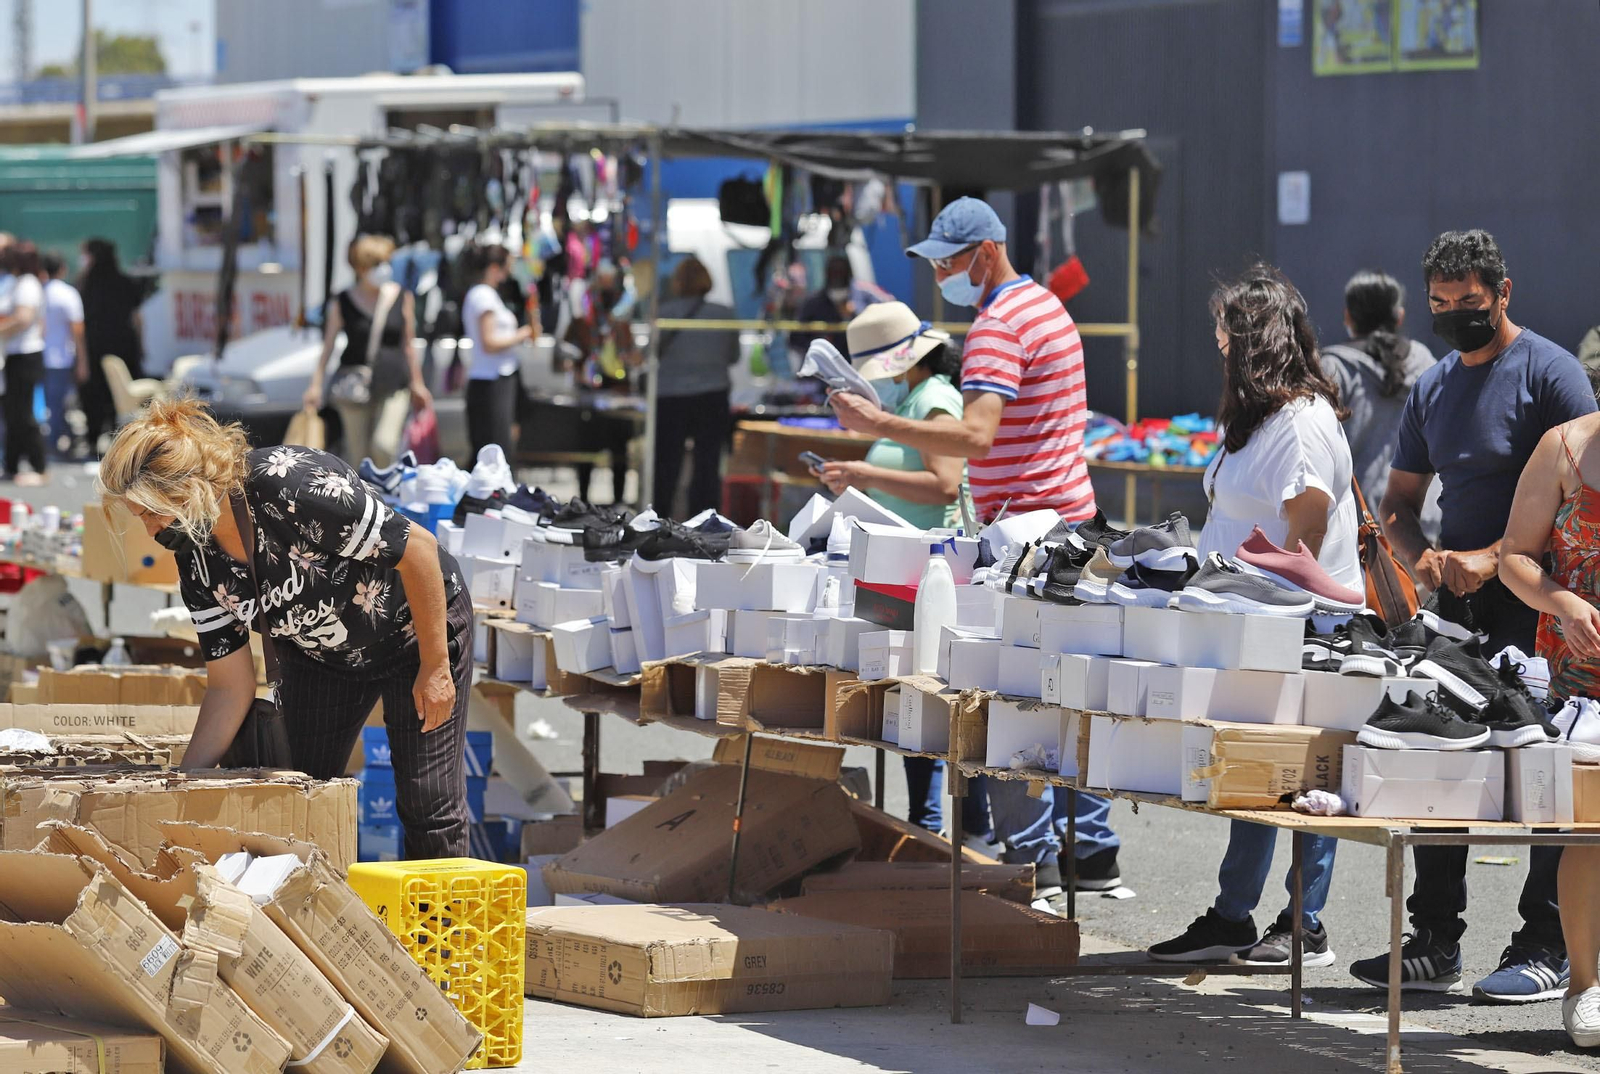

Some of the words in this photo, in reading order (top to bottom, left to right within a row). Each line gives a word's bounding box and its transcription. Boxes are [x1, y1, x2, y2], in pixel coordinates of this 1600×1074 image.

[270, 597, 334, 638] ibes
[53, 715, 92, 727] COLOR:
[94, 715, 136, 727] WHITE
[1315, 754, 1329, 788] LACK
[331, 915, 345, 933] 6603
[342, 924, 358, 943] GREY
[125, 925, 148, 952] 6609
[147, 957, 162, 976] BLACK
[162, 942, 176, 958] WHITE
[245, 946, 272, 979] WHITE
[744, 954, 767, 969] GREY
[746, 981, 785, 996] C8536
